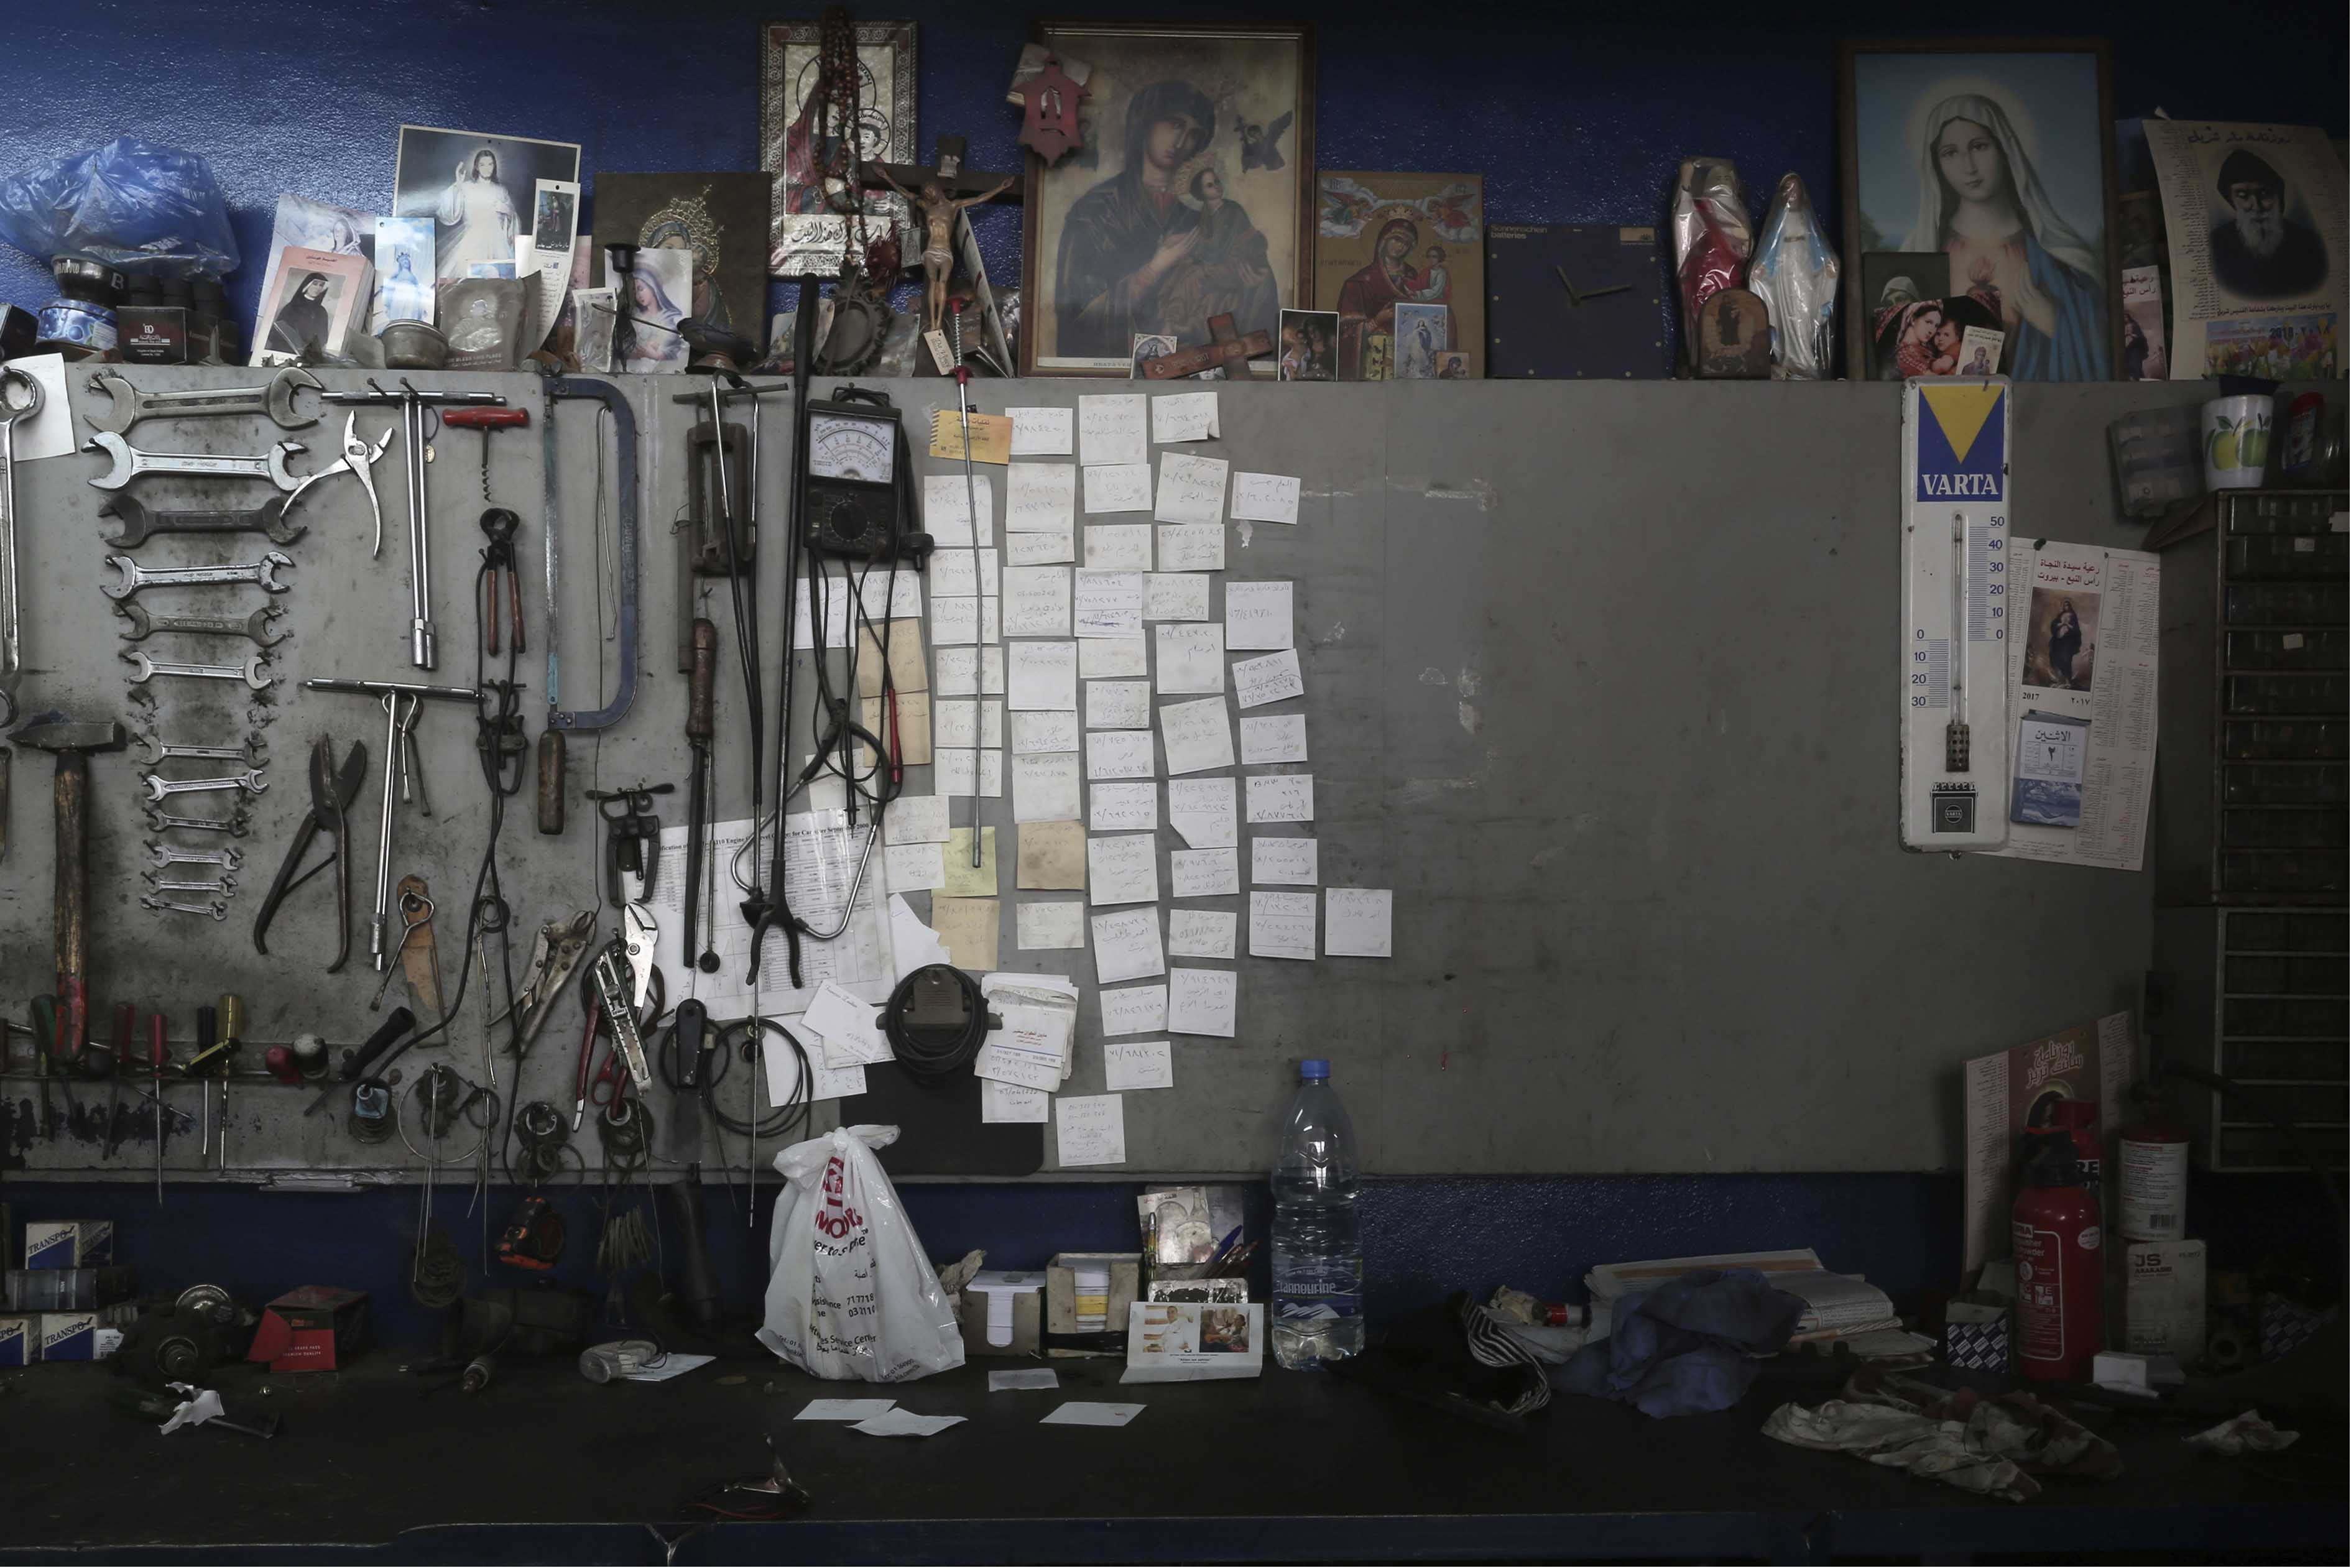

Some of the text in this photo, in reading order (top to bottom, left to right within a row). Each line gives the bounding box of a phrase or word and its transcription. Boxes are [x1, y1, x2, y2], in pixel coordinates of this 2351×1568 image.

[1921, 473, 2000, 496] VARTA
[1990, 516, 2005, 527] 50
[1988, 539, 2003, 550] 40
[1989, 561, 2004, 573] 30
[2063, 560, 2081, 571] سيدة
[2082, 562, 2100, 574] رعية
[2038, 571, 2059, 583] بيروت
[1989, 584, 2004, 595] 20
[1992, 607, 2003, 618] 10
[1917, 629, 1924, 640] 0
[1996, 629, 2003, 640] 0
[1915, 652, 1926, 662] 10
[1912, 674, 1926, 685] 20
[1911, 696, 1926, 707] 30
[2022, 691, 2040, 701] 2017
[2070, 696, 2090, 706] ٢٠١٧
[2035, 729, 2071, 742] الاثنين
[2048, 745, 2056, 762] ٢
[659, 844, 682, 852] ification
[726, 837, 745, 845] Engine
[28, 1228, 67, 1255] TRANSPO
[2135, 1253, 2161, 1267] JS
[45, 1319, 85, 1345] TRANSPO
